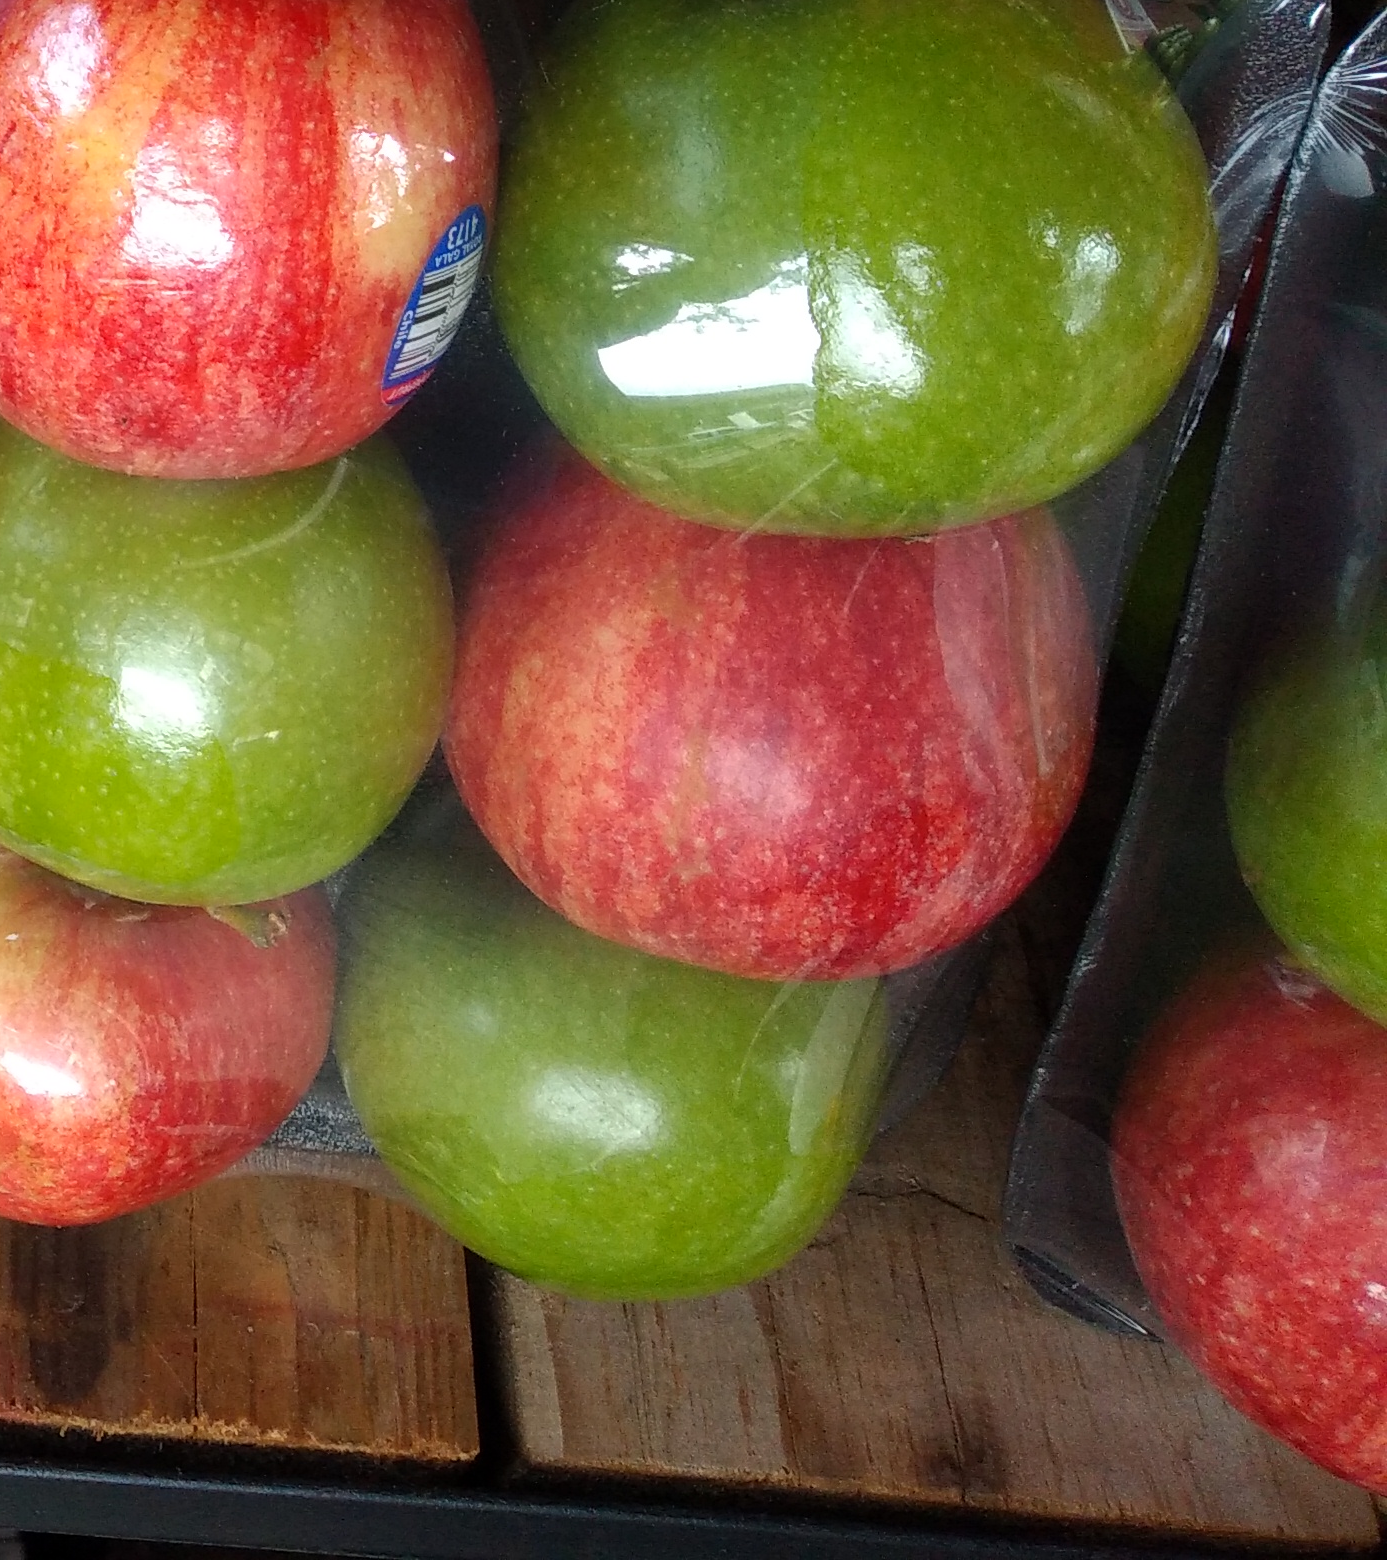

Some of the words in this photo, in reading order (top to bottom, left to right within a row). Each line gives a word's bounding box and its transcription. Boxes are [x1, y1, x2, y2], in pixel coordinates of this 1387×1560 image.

[447, 215, 479, 250] 4173
[435, 249, 461, 268] GALA
[393, 309, 414, 350] Chile
